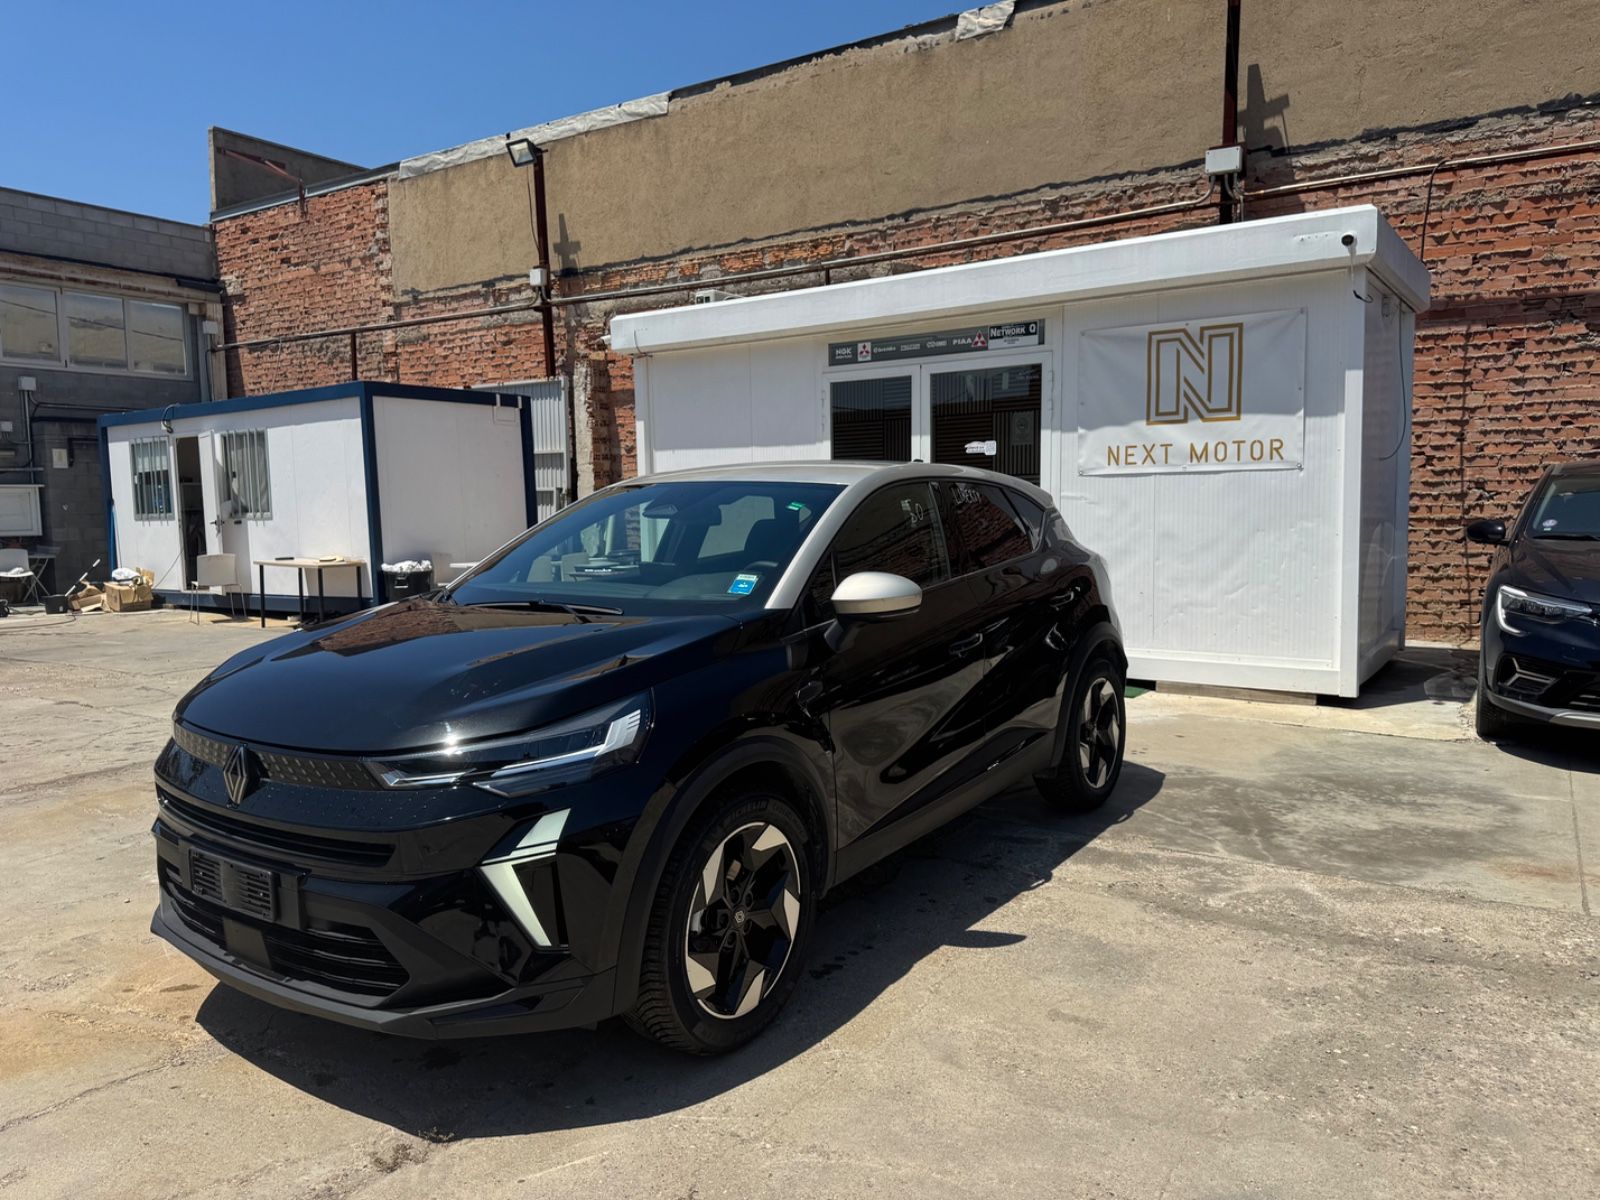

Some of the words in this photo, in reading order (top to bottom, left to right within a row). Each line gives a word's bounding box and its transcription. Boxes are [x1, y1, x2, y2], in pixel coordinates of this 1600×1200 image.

[952, 337, 972, 346] PIAA
[1107, 443, 1174, 467] NEXT
[1189, 438, 1285, 464] MOTOR
